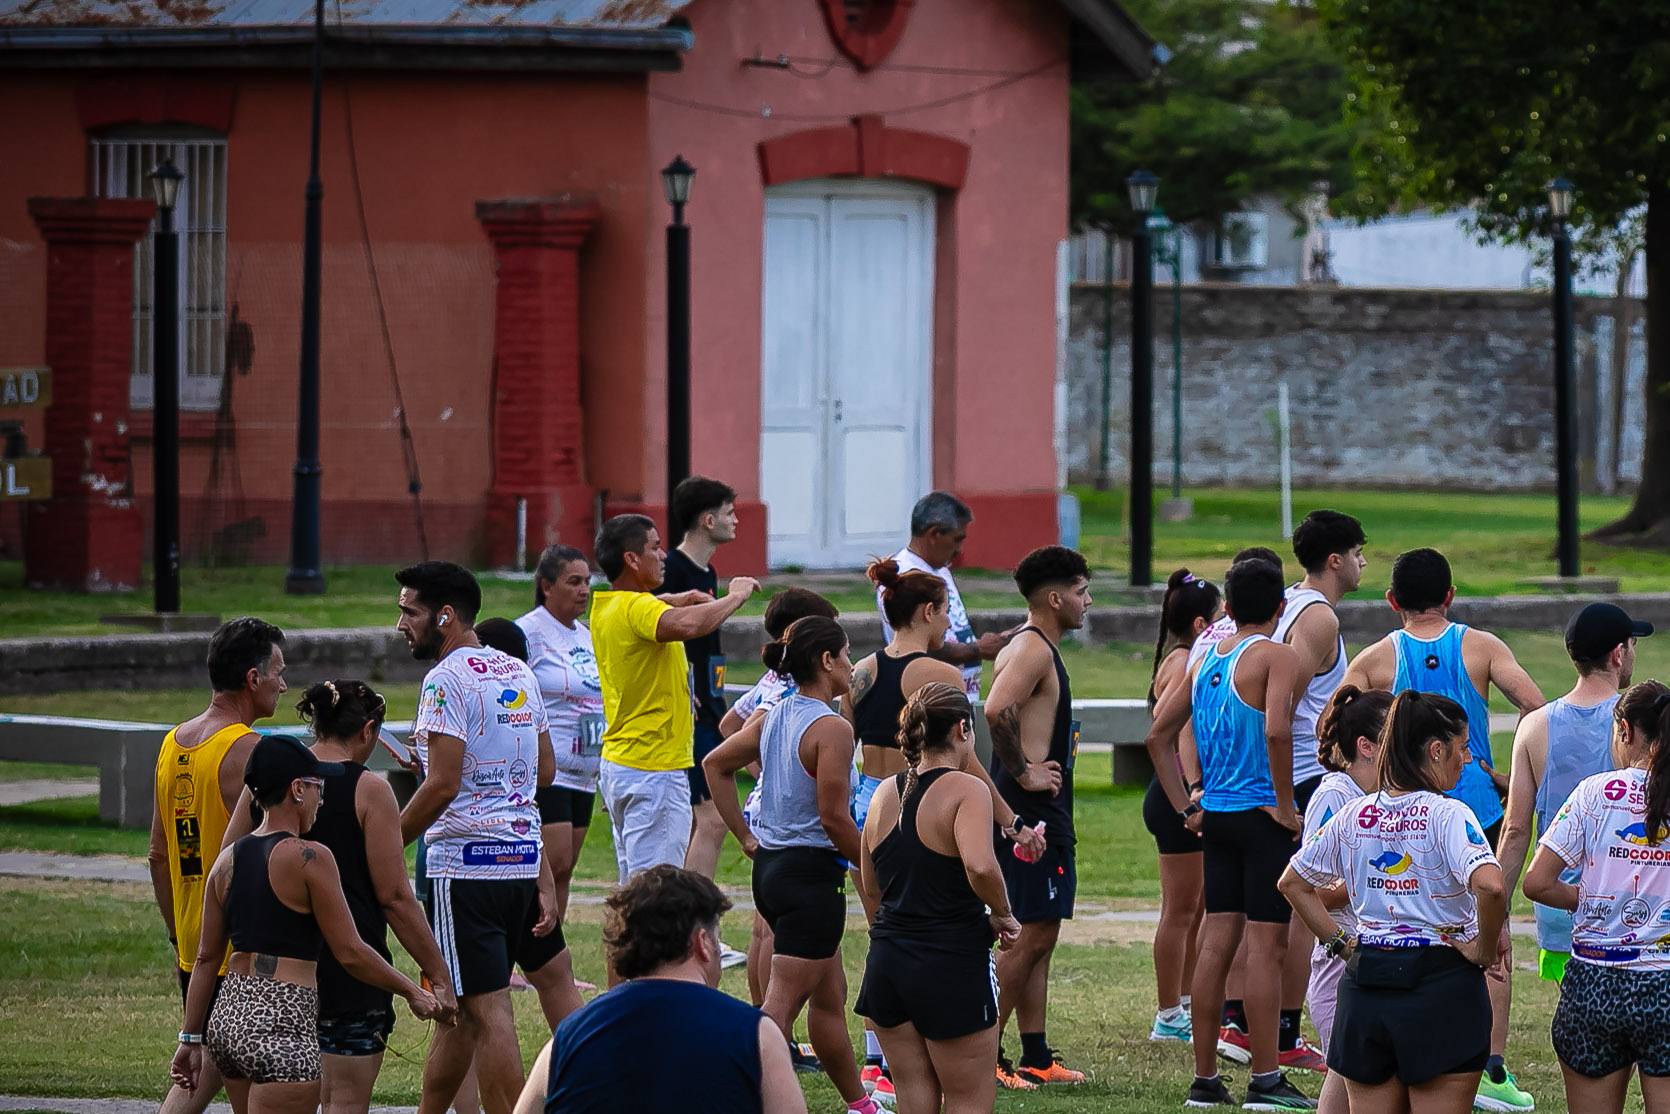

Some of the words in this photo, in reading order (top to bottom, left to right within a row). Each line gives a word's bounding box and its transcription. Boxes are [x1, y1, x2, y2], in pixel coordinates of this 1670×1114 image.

[3, 371, 39, 404] AD
[0, 463, 30, 495] L
[472, 845, 513, 856] ESTEBAN
